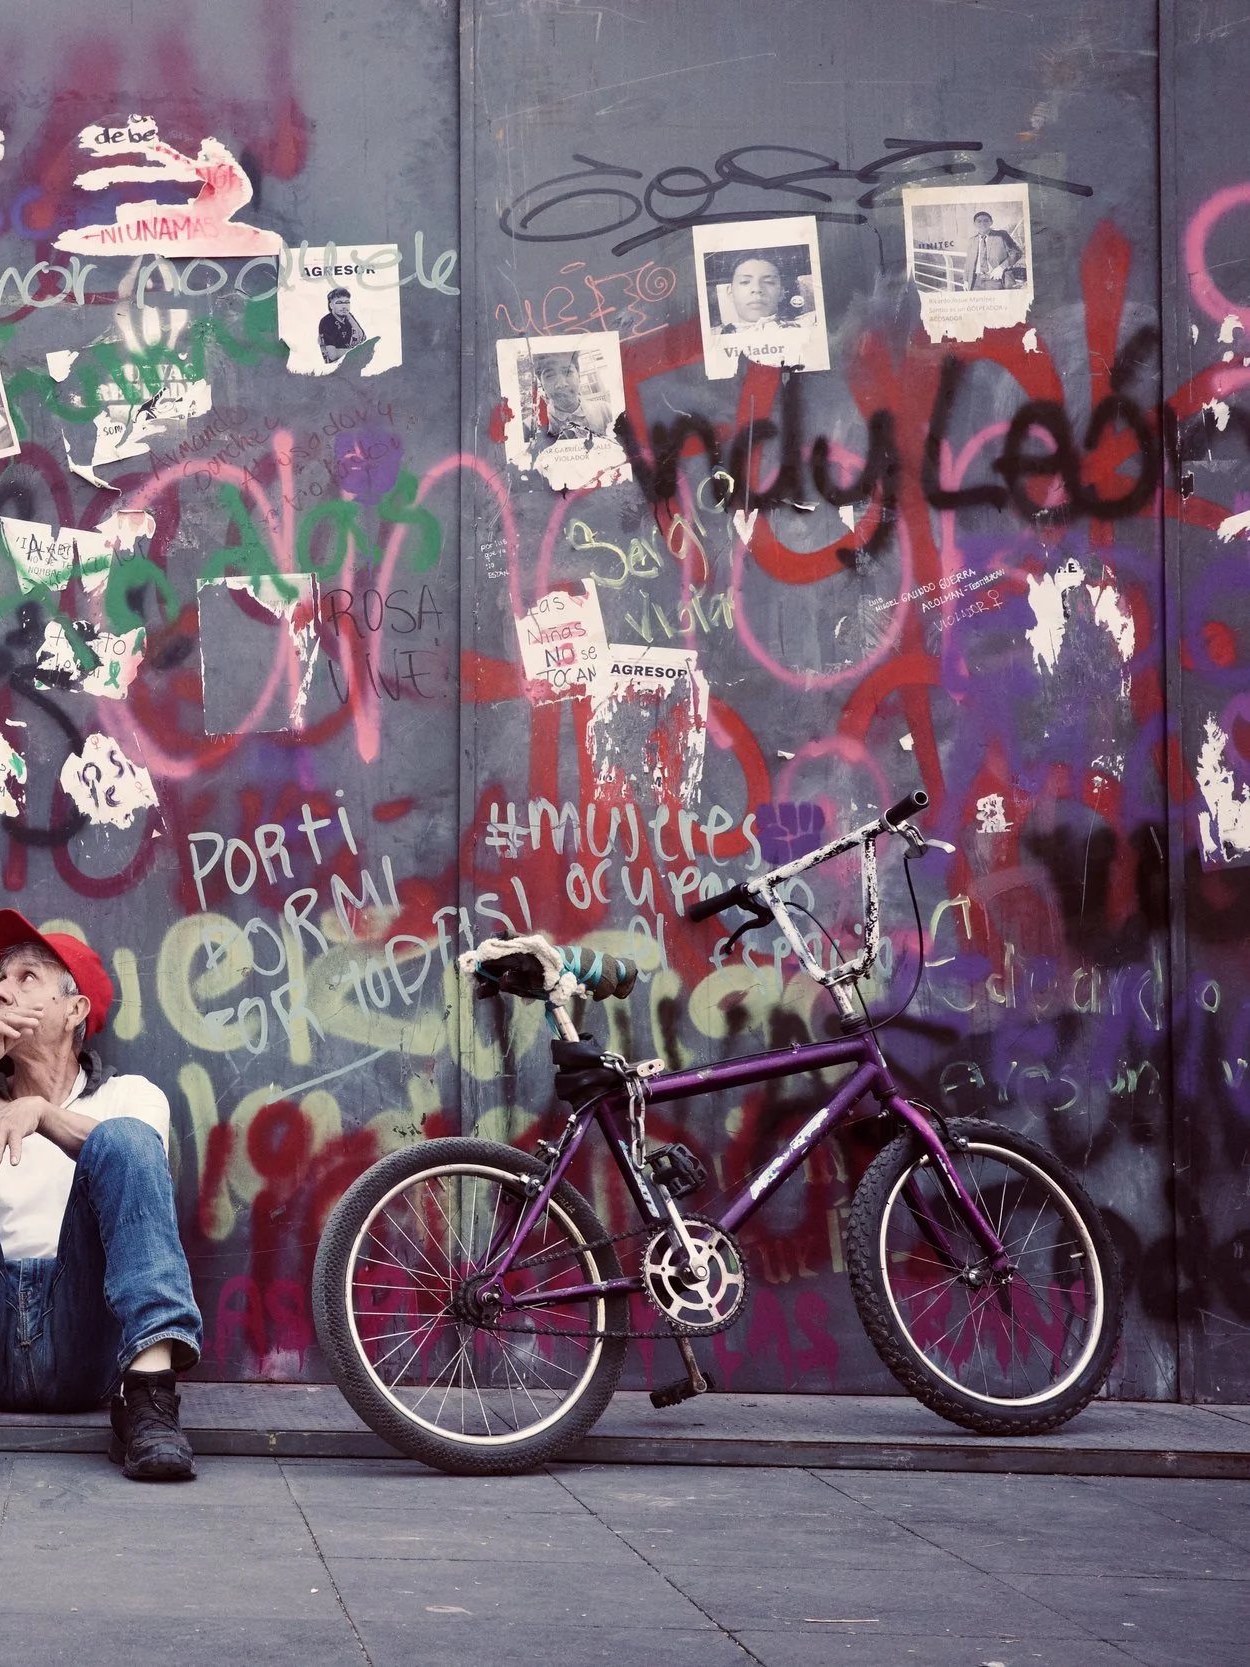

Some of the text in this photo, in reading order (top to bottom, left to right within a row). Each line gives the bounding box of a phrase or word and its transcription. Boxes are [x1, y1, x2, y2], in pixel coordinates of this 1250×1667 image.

[135, 256, 228, 310] no
[233, 231, 461, 301] duele
[724, 344, 786, 359] Vilador
[938, 568, 977, 590] GUERRA
[536, 666, 597, 688] TOCAN
